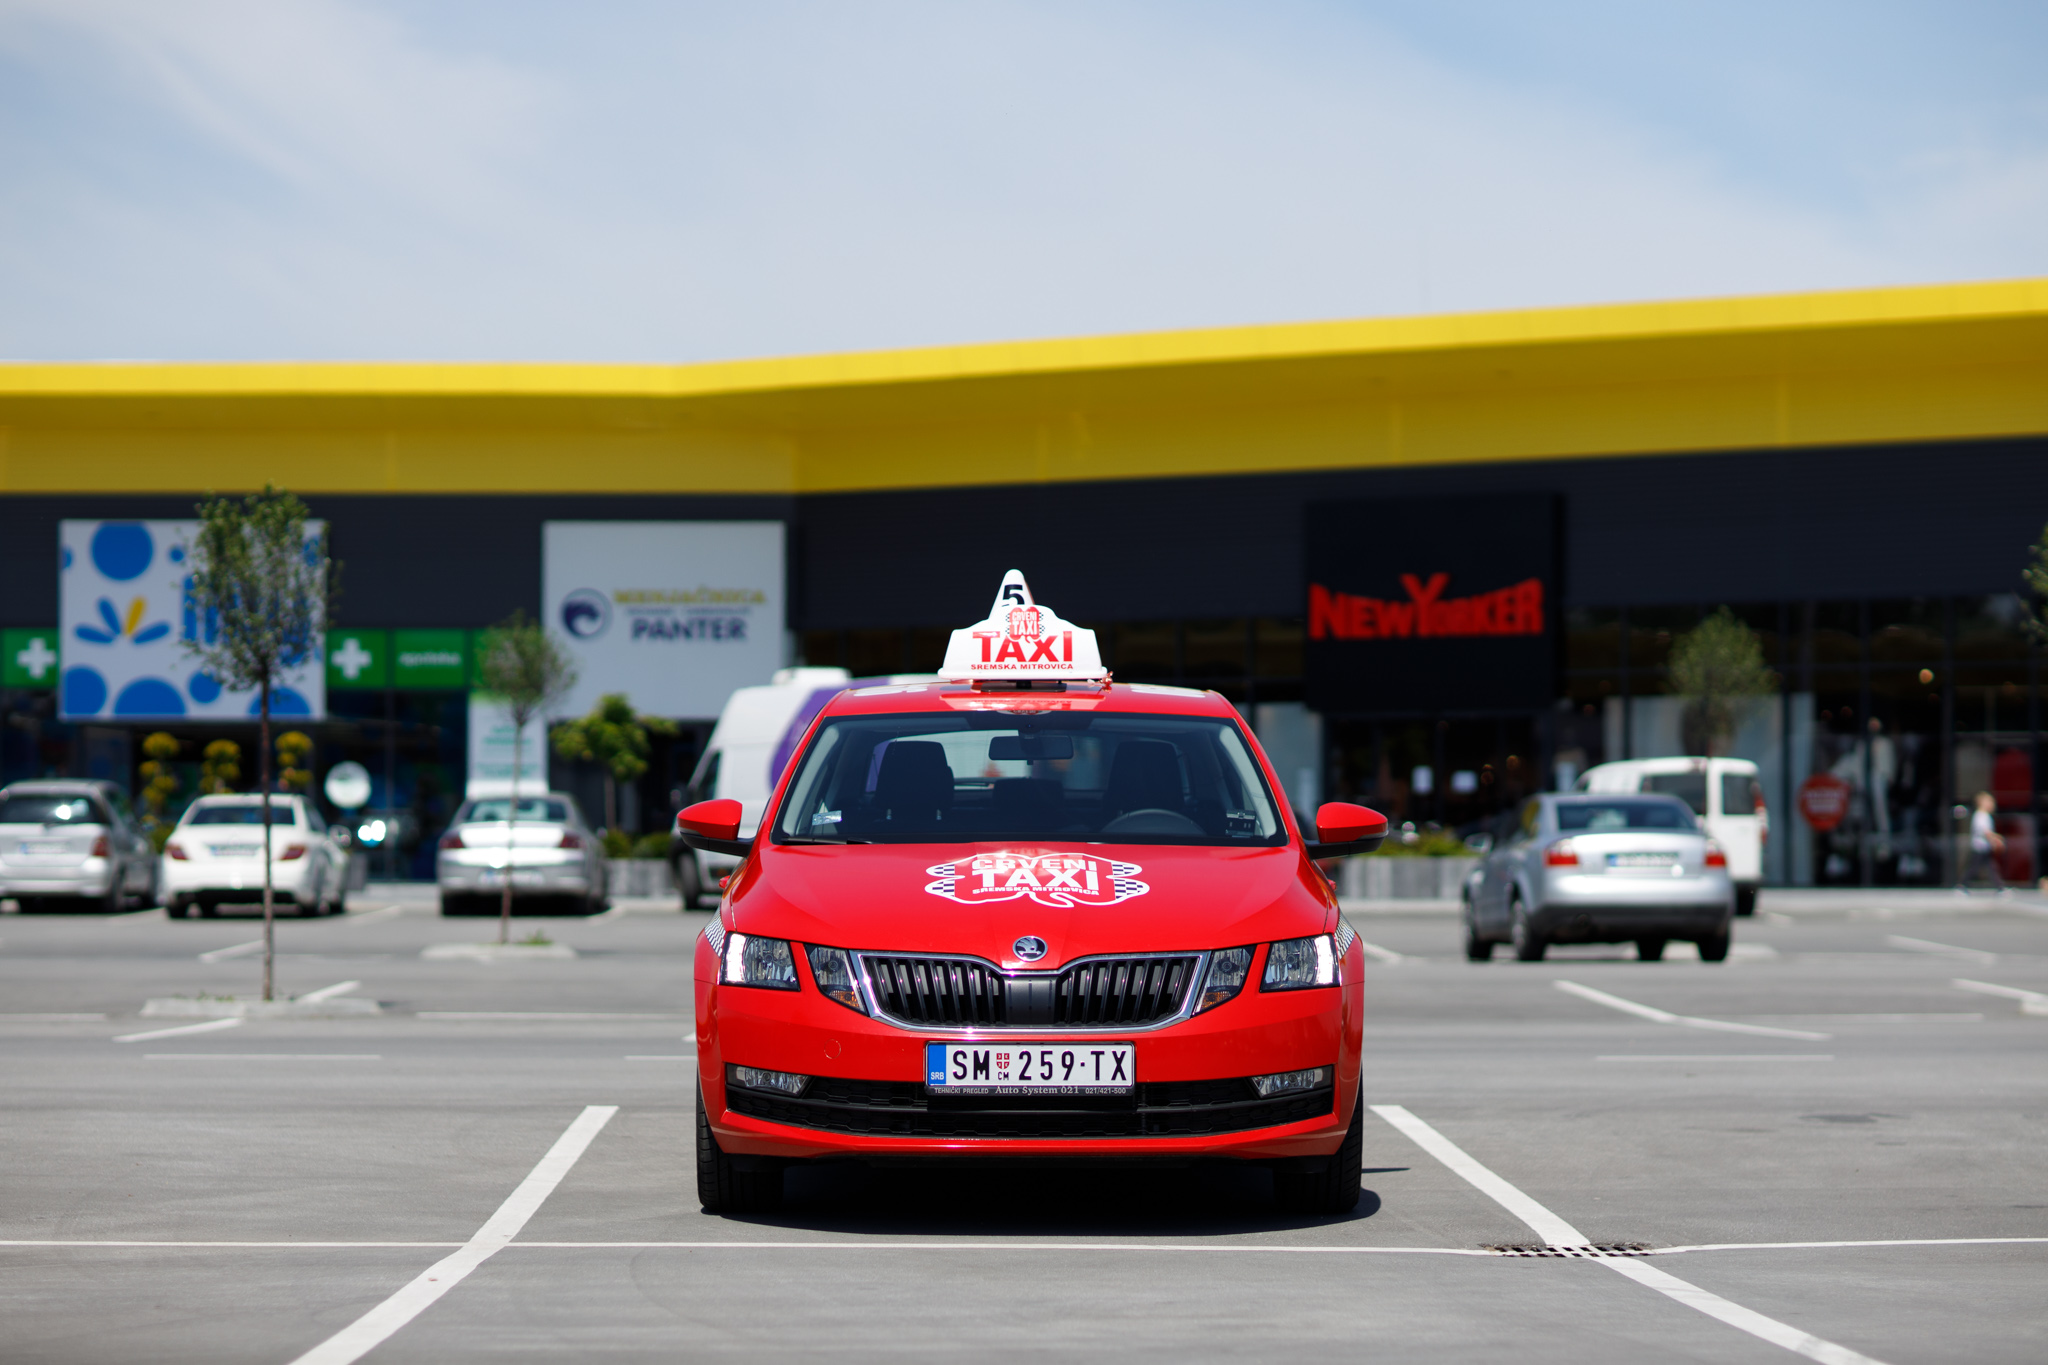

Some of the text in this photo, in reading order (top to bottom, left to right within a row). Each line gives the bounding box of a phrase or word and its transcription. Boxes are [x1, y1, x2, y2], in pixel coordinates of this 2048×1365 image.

[1002, 584, 1025, 607] 5
[1012, 611, 1038, 621] CRVENI
[631, 617, 746, 640] PANTER
[1012, 620, 1038, 636] TAXI
[972, 630, 1073, 663] TAXI
[972, 859, 1097, 871] CRVENI
[972, 868, 1099, 890] TAXI
[972, 886, 1100, 896] SREMSKA MITROVICA
[952, 1050, 990, 1081] SM
[930, 1072, 945, 1080] SRB
[934, 1086, 961, 1094] TEHNIČKI
[995, 1086, 1019, 1094] Auto
[1022, 1086, 1058, 1095] System
[1060, 1086, 1079, 1094] 021
